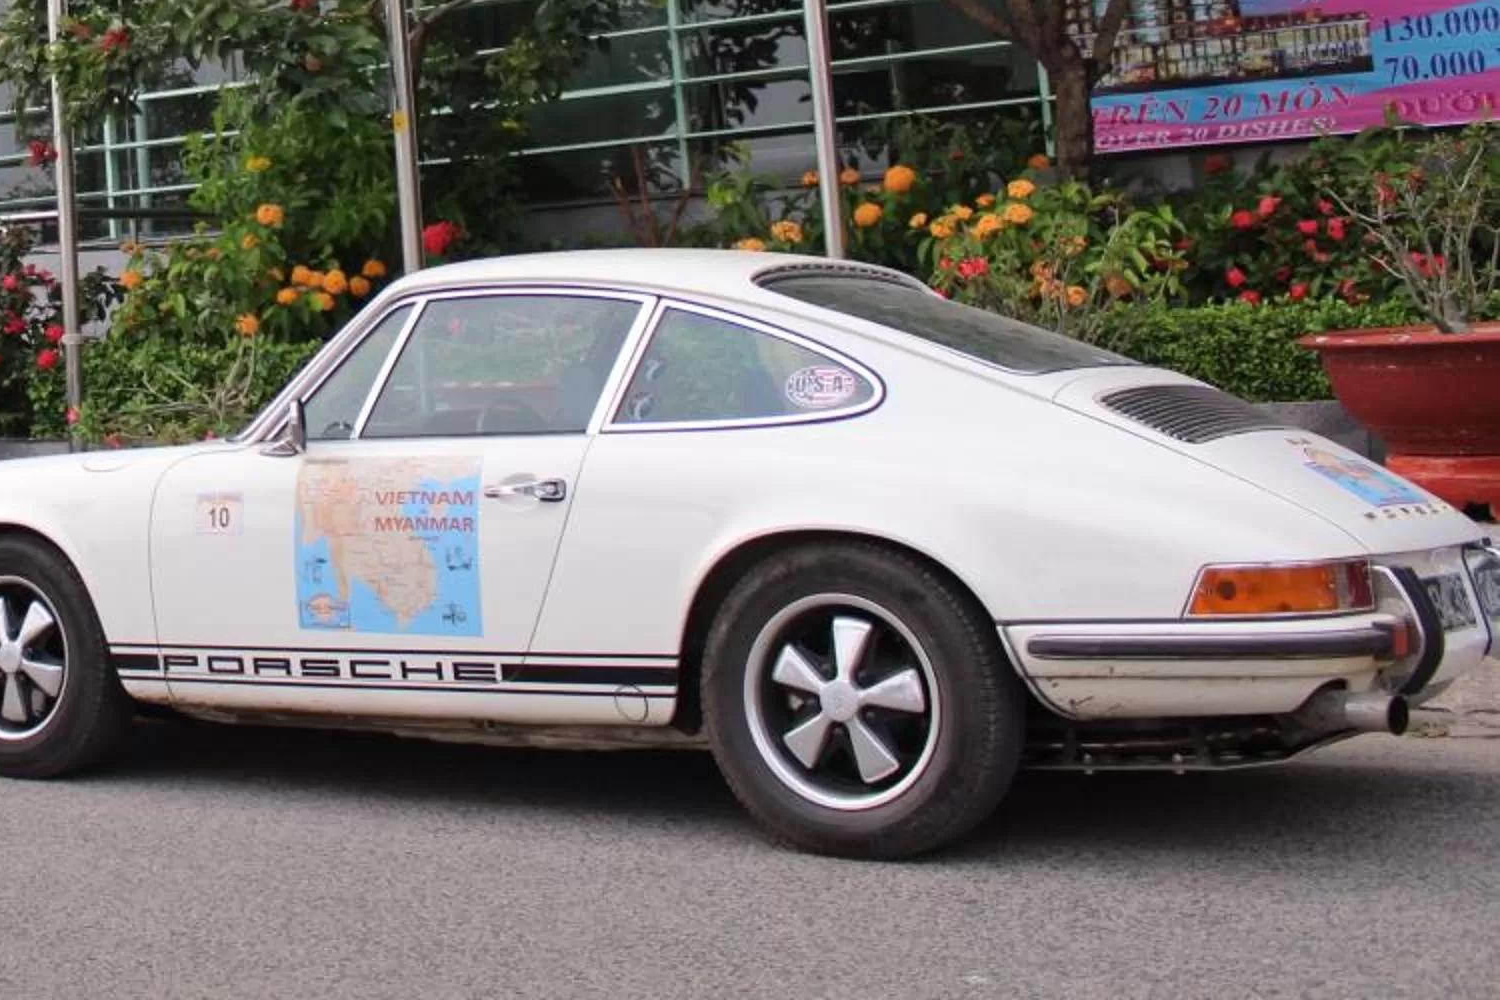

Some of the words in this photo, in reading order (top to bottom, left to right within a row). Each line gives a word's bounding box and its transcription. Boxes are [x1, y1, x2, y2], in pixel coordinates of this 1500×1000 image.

[1384, 5, 1499, 42] 130.000
[1384, 49, 1485, 84] 70.000
[1203, 96, 1242, 120] 20
[375, 490, 474, 505] VIETNAM
[208, 507, 230, 529] 10
[375, 515, 475, 532] MYANMAR
[163, 655, 499, 683] PORSCHE
